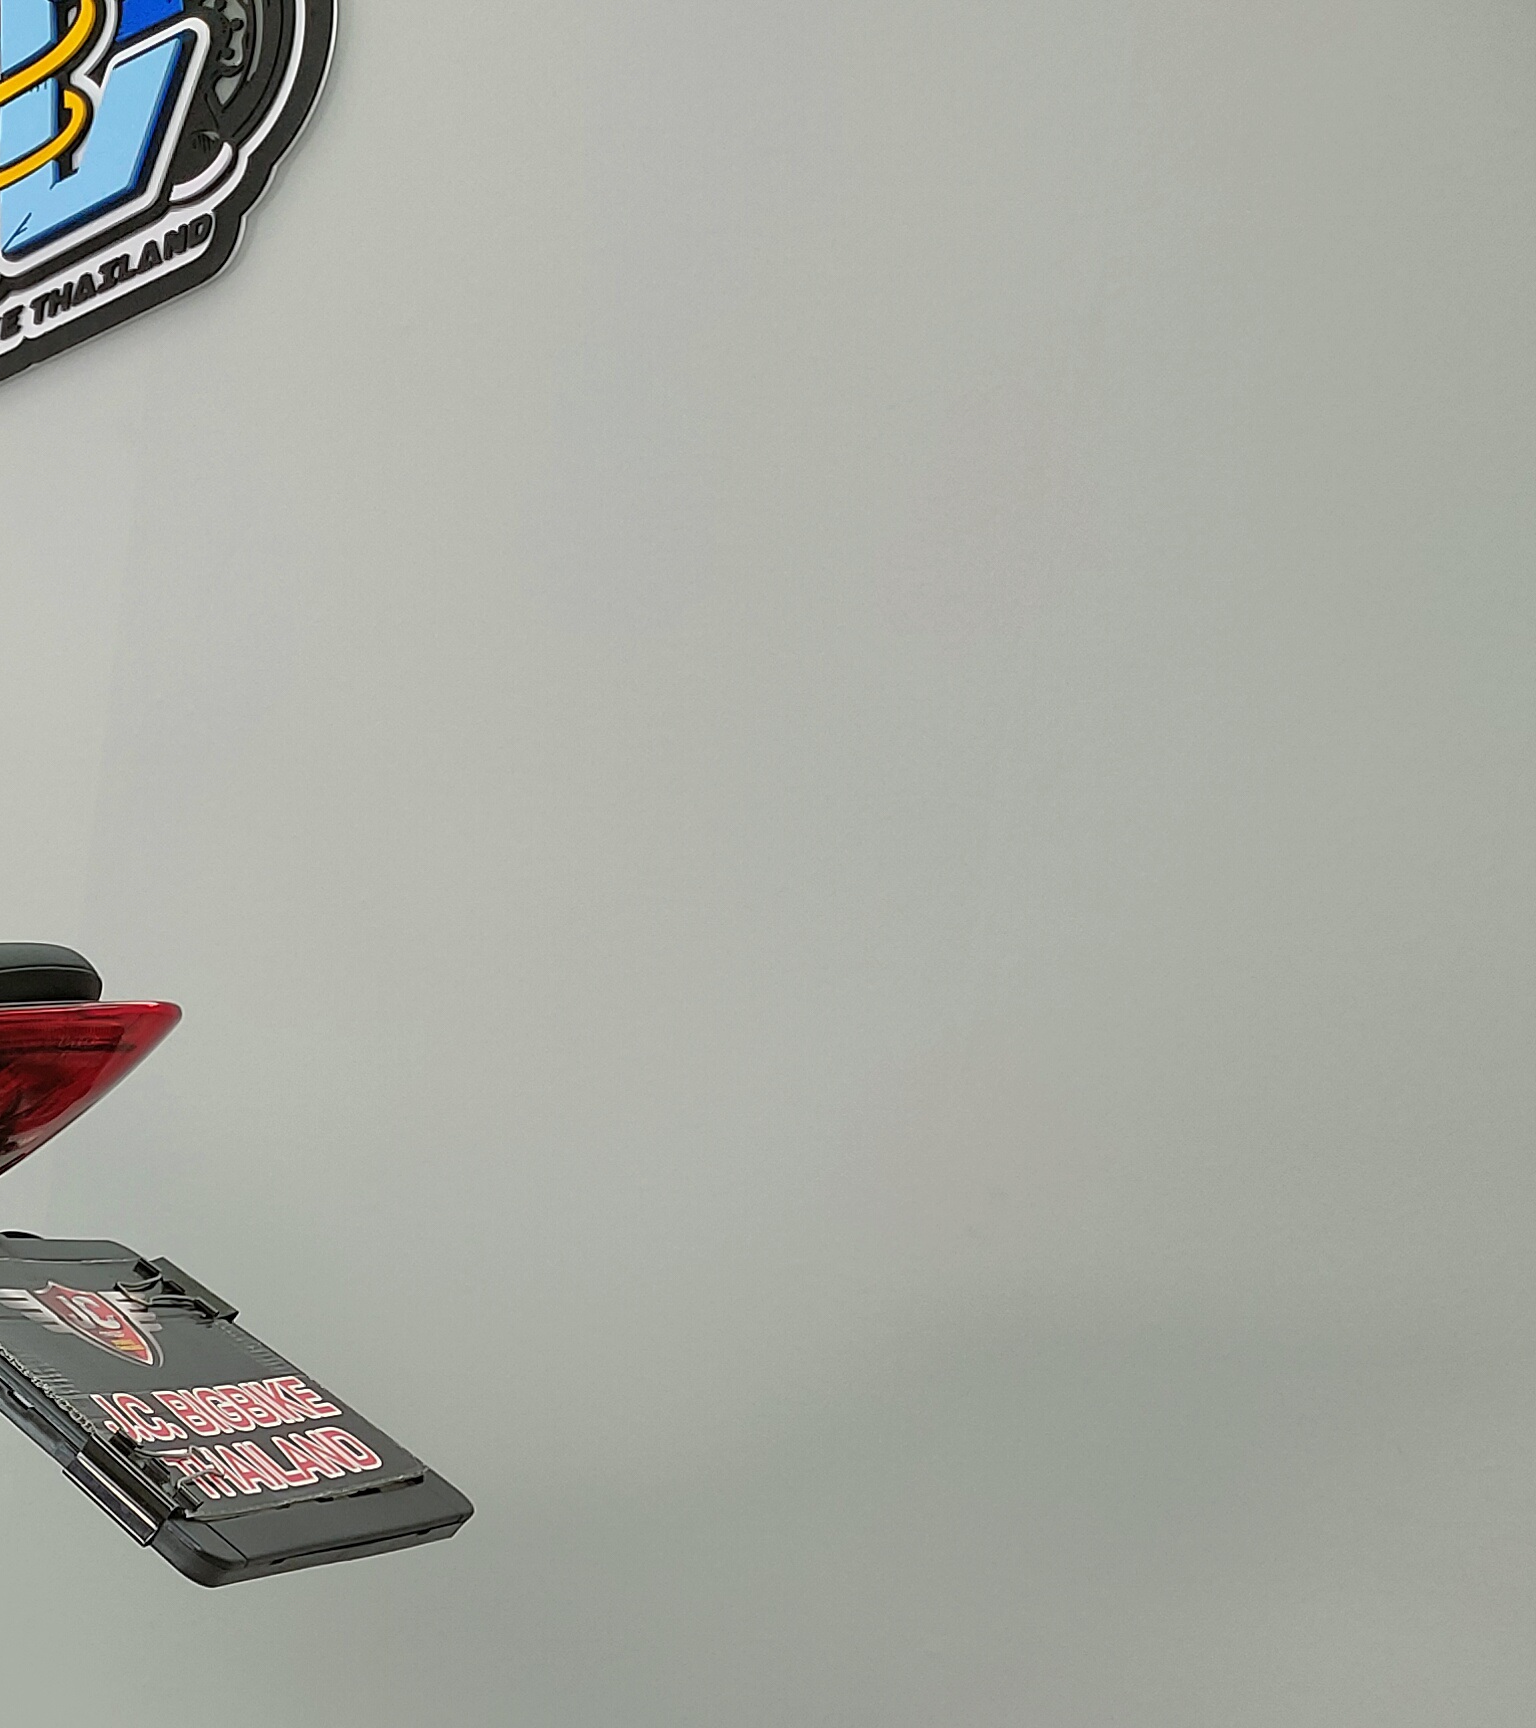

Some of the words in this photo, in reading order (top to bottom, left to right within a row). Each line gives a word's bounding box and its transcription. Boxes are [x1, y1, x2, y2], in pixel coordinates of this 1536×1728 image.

[28, 212, 215, 326] THAILAND
[151, 1375, 344, 1438] BIGBIKE
[161, 1426, 384, 1501] THAILAND
